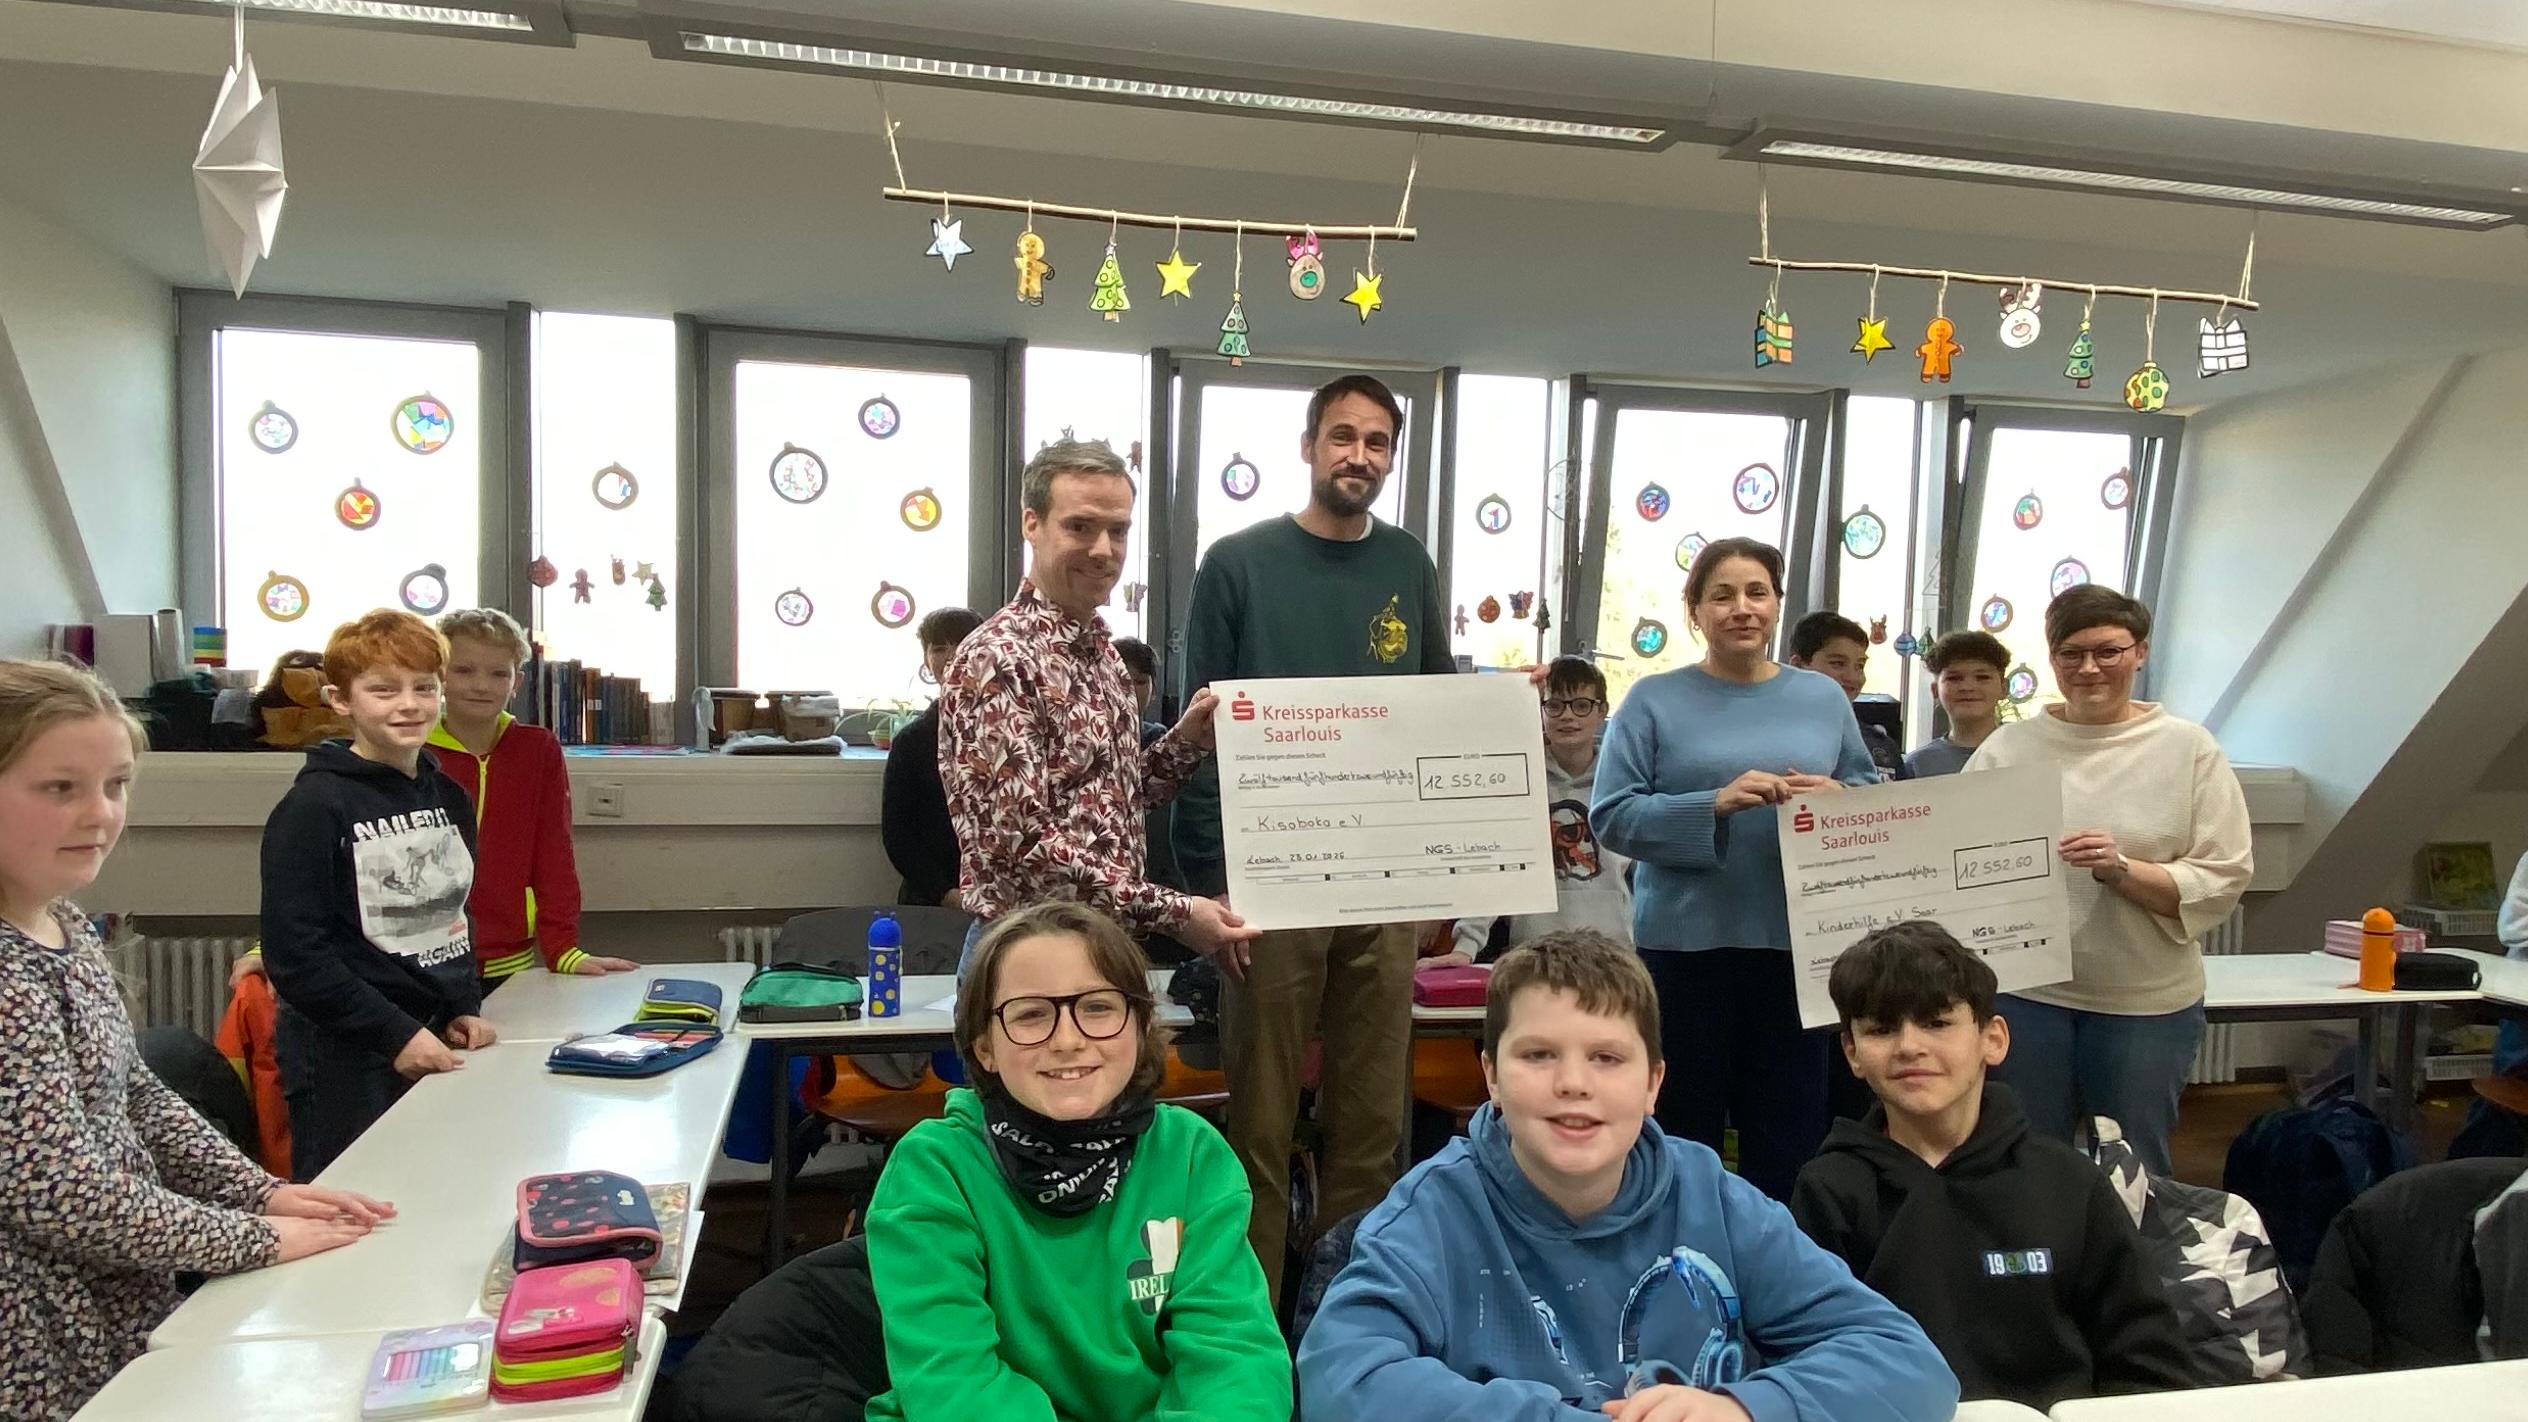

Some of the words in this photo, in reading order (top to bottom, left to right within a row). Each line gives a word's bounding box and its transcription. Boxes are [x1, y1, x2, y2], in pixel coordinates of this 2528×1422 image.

[1262, 703, 1389, 723] Kreissparkasse
[1264, 725, 1342, 743] Saarlouis
[1424, 775, 1444, 790] 12
[1820, 805, 1932, 830] Kreissparkasse
[1425, 843, 1454, 855] NGS
[1821, 830, 1890, 850] Saarlouis
[1959, 861, 1978, 880] 12
